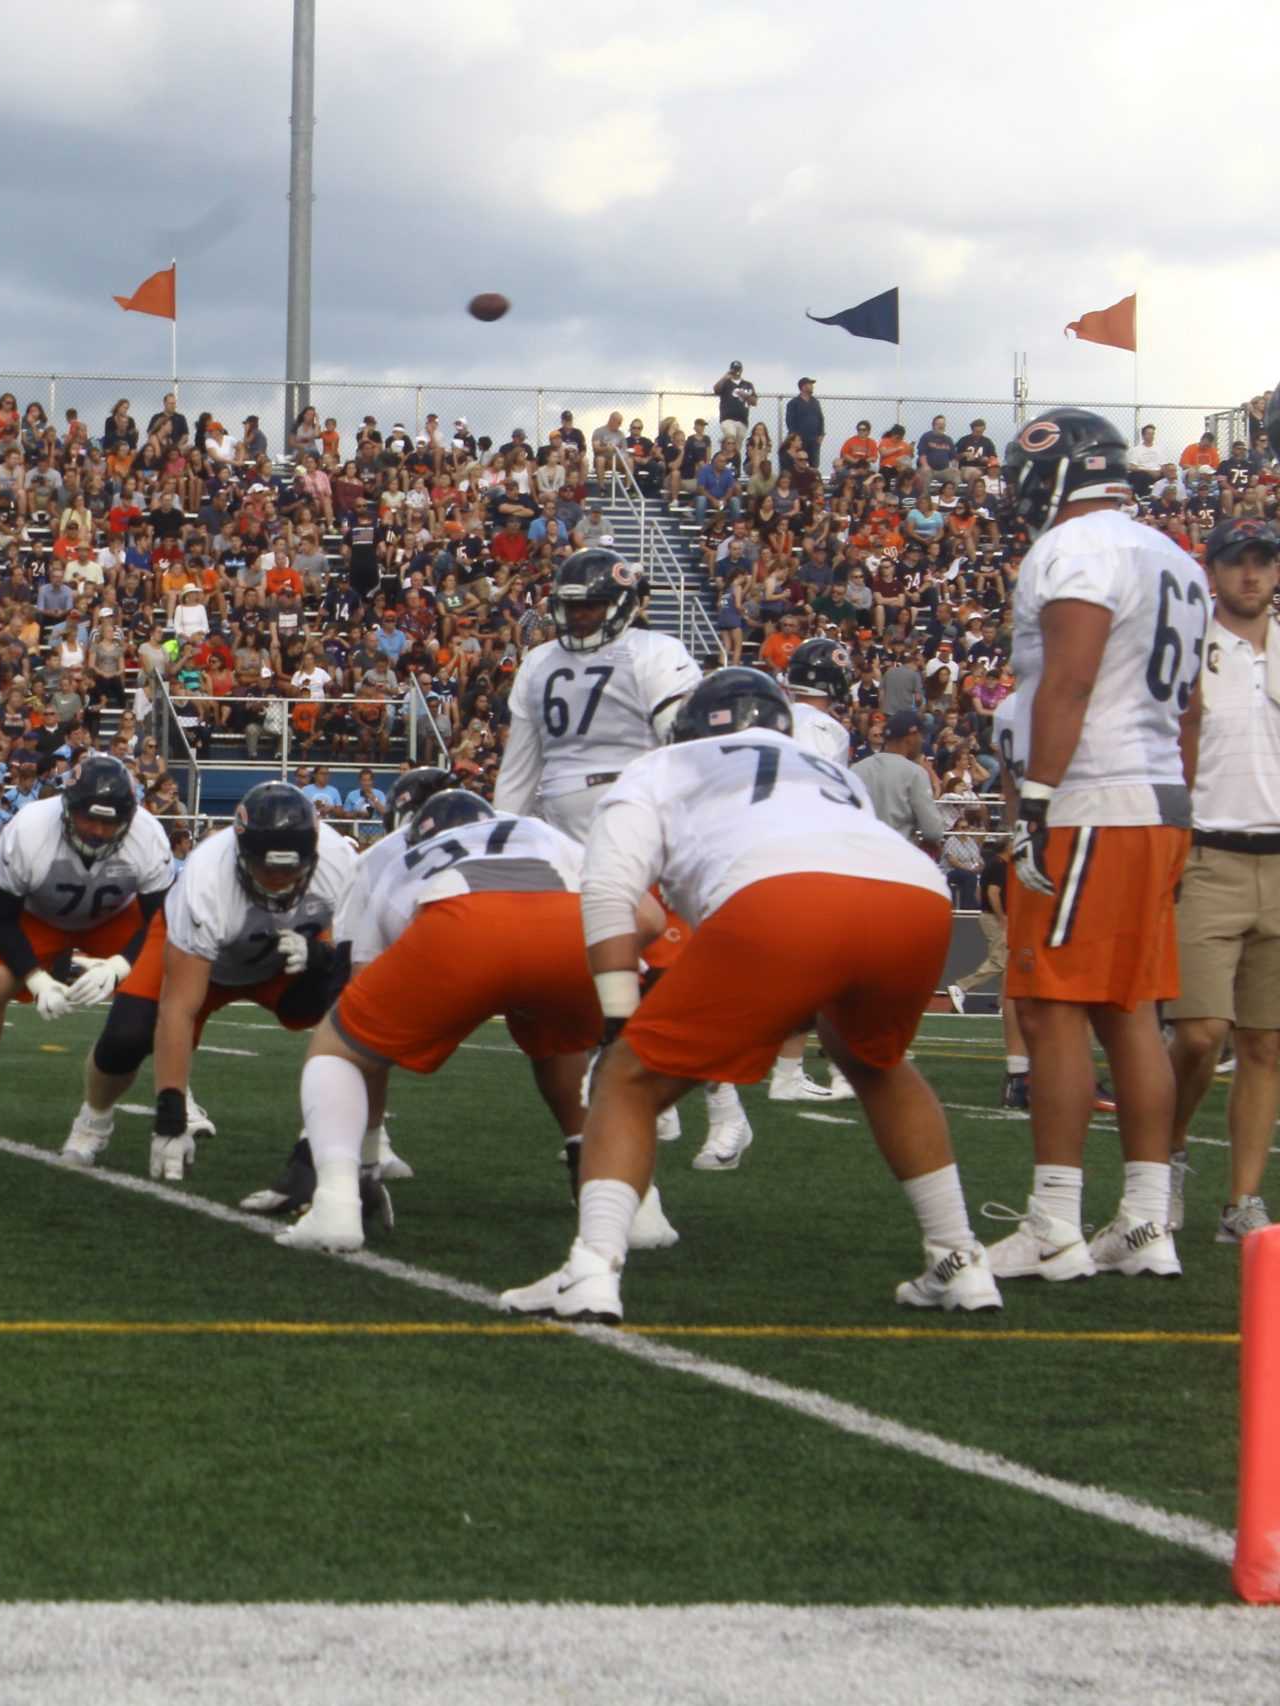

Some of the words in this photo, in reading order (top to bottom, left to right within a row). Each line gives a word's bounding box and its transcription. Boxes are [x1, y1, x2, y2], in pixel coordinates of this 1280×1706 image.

[1231, 468, 1249, 484] 75
[335, 603, 350, 621] 14
[1146, 569, 1208, 710] 63
[543, 665, 615, 738] 67
[1124, 1221, 1161, 1250] NIKE
[934, 1251, 968, 1284] NIKE
